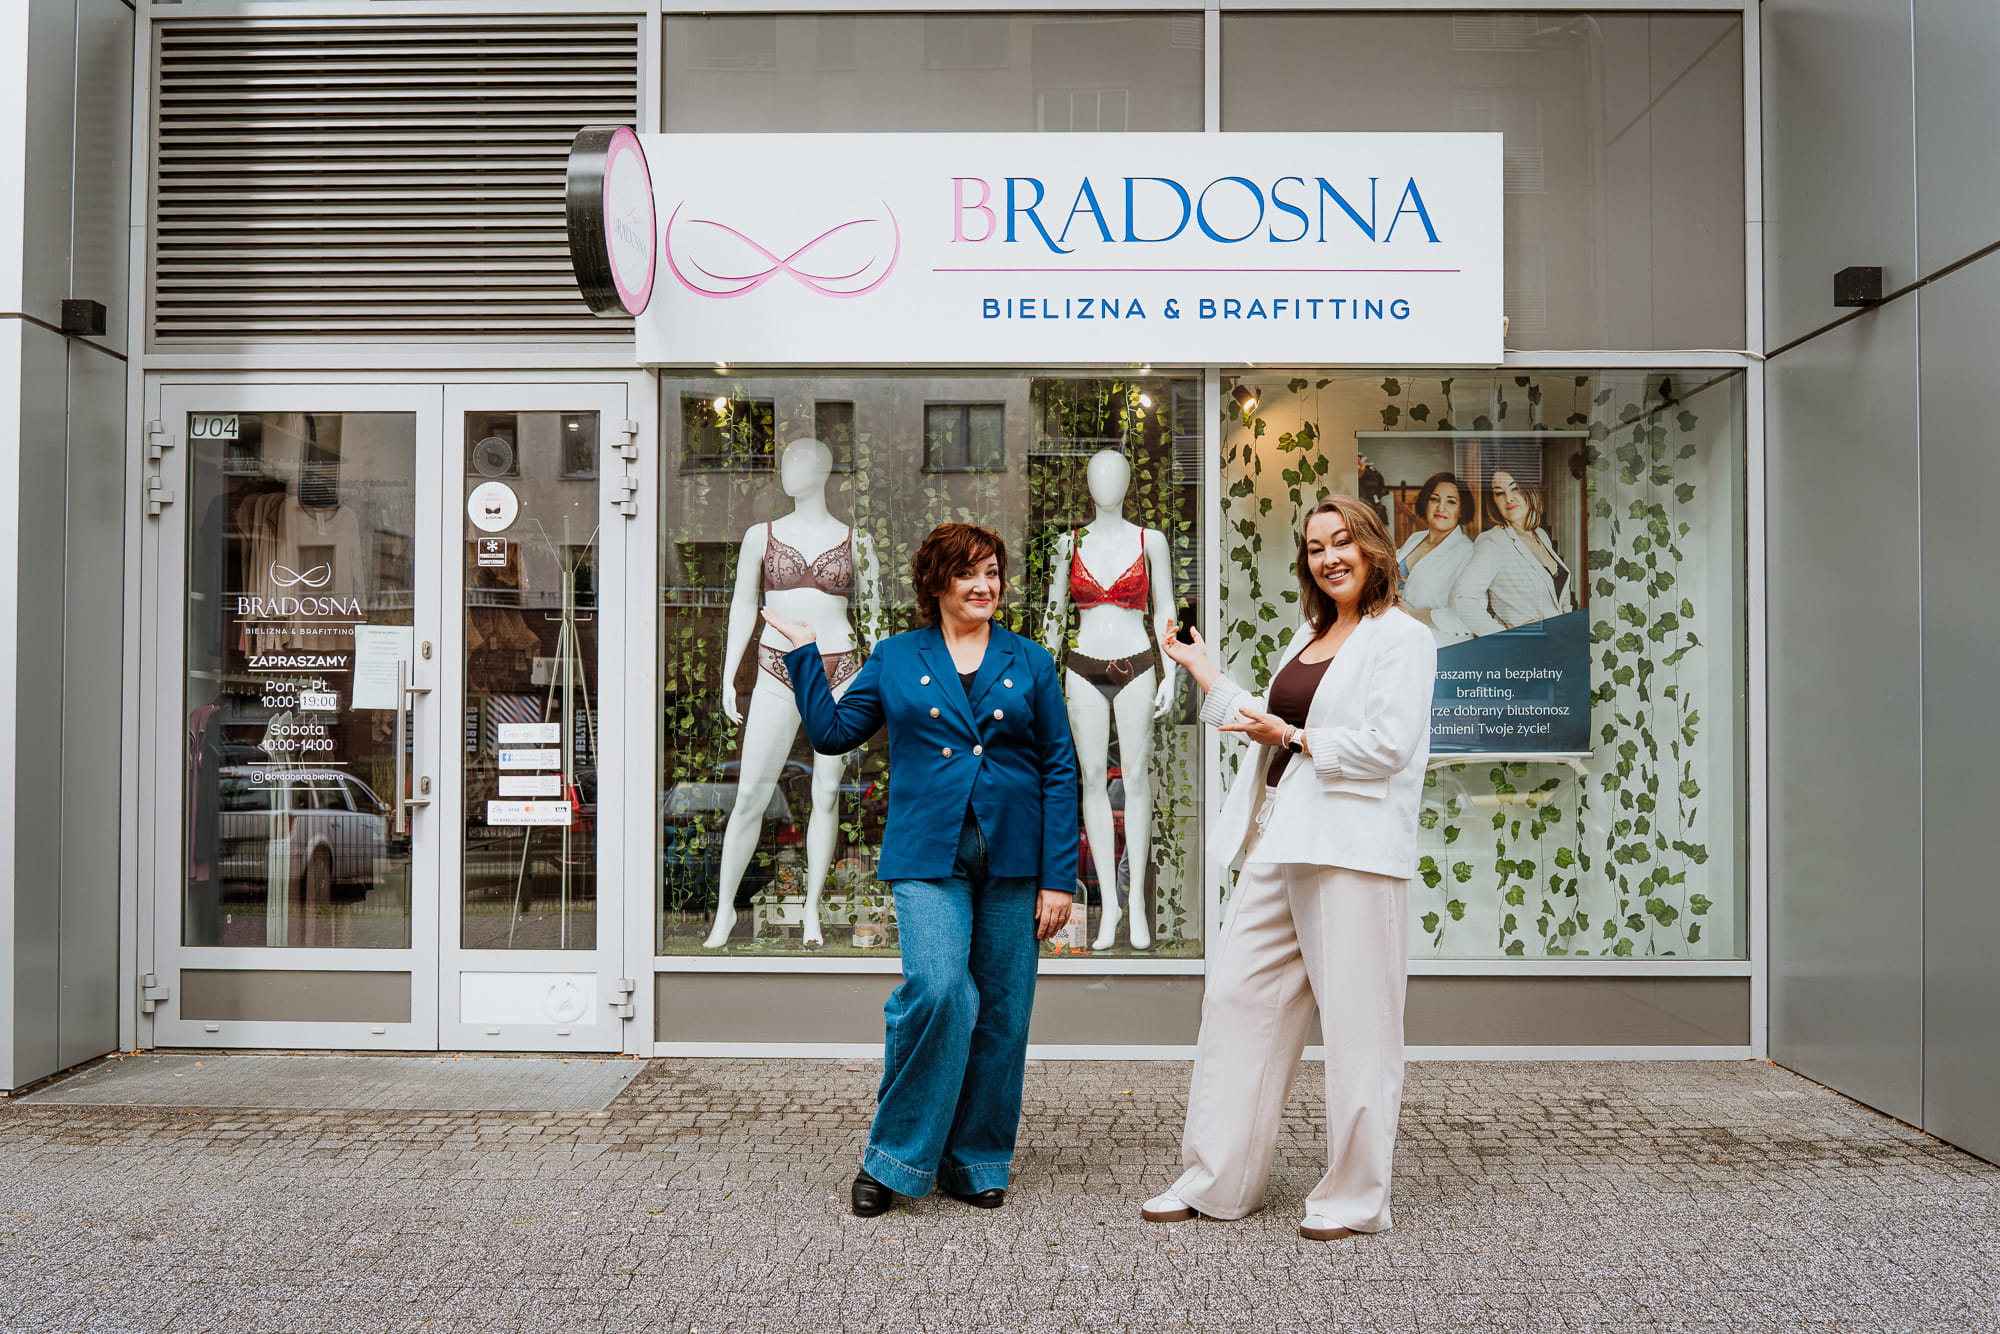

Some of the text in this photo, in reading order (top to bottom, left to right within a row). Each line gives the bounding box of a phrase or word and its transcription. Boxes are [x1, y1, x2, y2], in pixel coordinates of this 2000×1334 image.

[952, 175, 1441, 254] BRADOSNA
[983, 299, 1411, 320] BIELIZNA & BRAFITTING
[191, 417, 238, 437] U04
[237, 596, 363, 618] BRADOSNA
[245, 627, 355, 636] BIELIZNA & BRAFITTING
[248, 655, 348, 668] ZAPRASZAMY
[1434, 667, 1563, 683] raszamy na bezpłatny
[265, 680, 298, 692] Pon.
[312, 680, 331, 693] Pt.
[1456, 686, 1515, 701] brafitting.
[1431, 704, 1570, 719] rze dobrany biustonosz
[270, 723, 325, 736] Sobota
[1477, 723, 1514, 737] Twoje
[1516, 722, 1550, 737] życie!
[261, 738, 334, 752] 10:00-14:00
